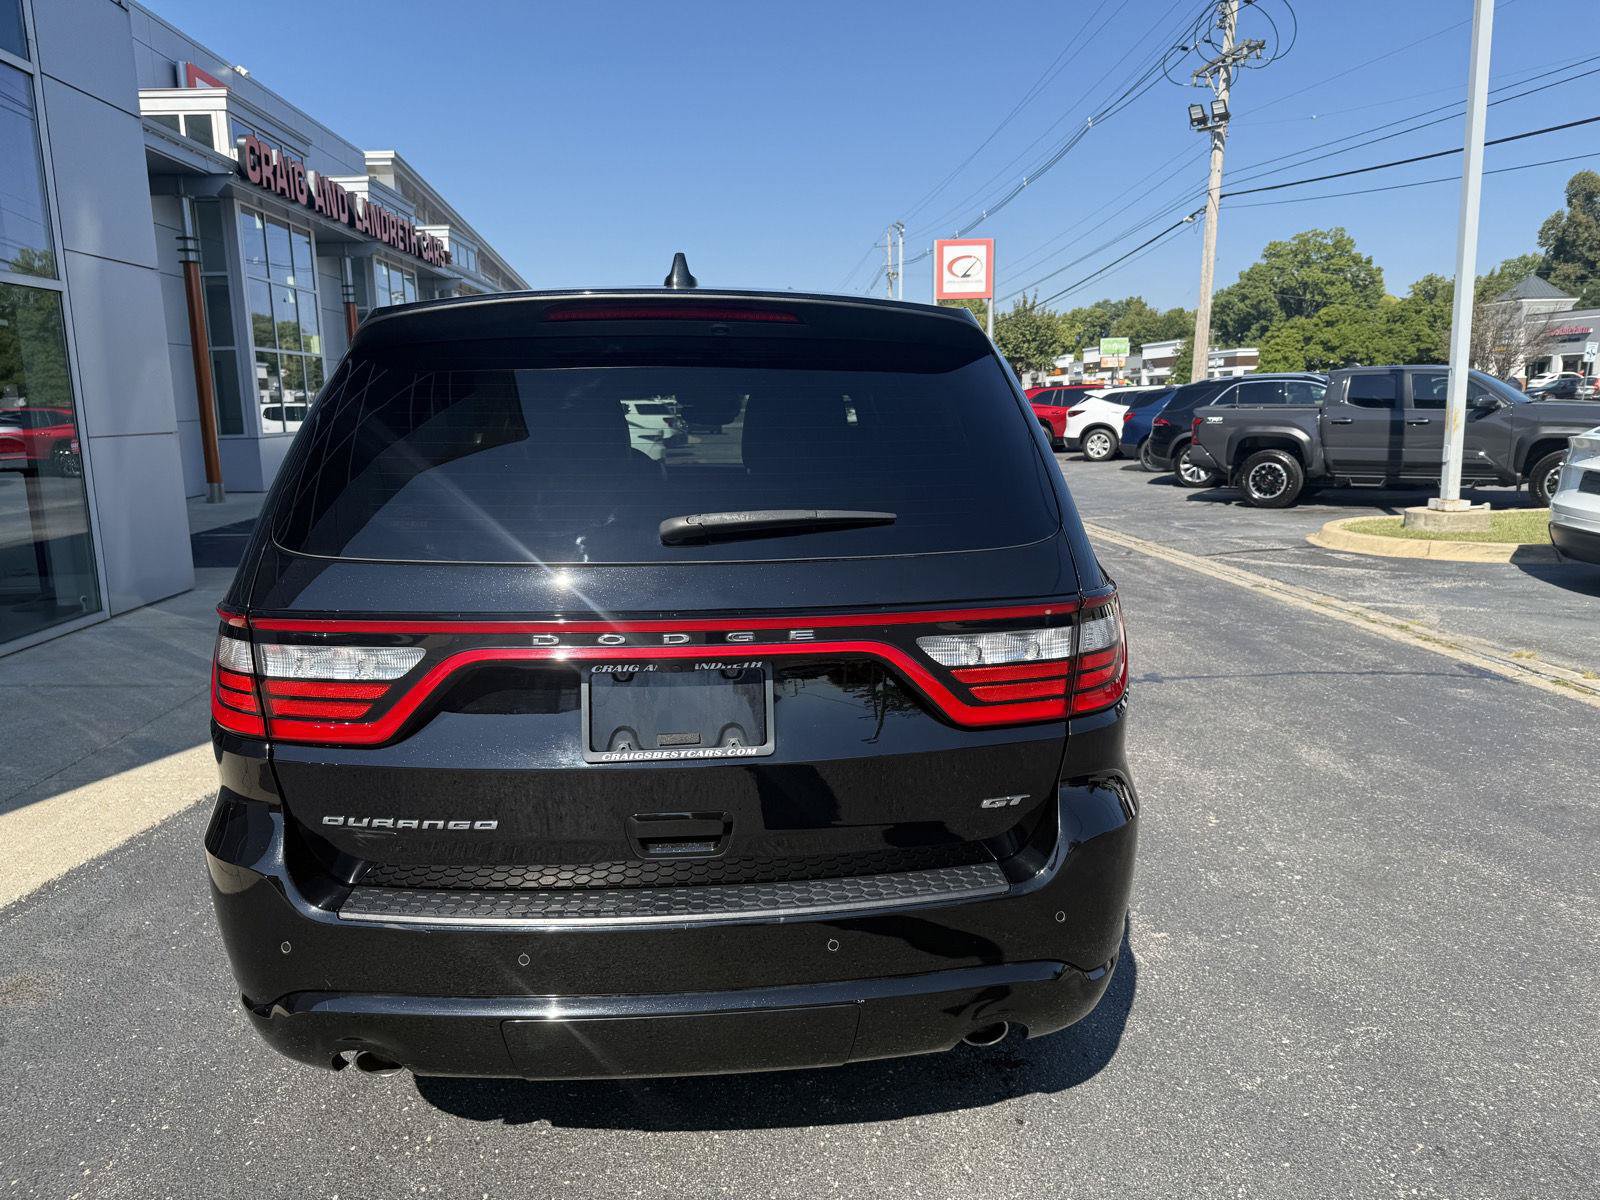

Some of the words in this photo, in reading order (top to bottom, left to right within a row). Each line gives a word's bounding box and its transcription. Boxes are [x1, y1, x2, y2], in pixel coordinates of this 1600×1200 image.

[243, 134, 309, 206] CRAIG
[312, 170, 349, 222] AND
[352, 194, 419, 257] LANDRETH
[420, 229, 447, 268] CARS
[532, 629, 815, 646] DODGE
[591, 664, 640, 673] CRAIG
[602, 748, 757, 761] CRAIGSBESTCARS.COM
[981, 794, 1031, 809] GT
[322, 815, 499, 830] DURANGO
